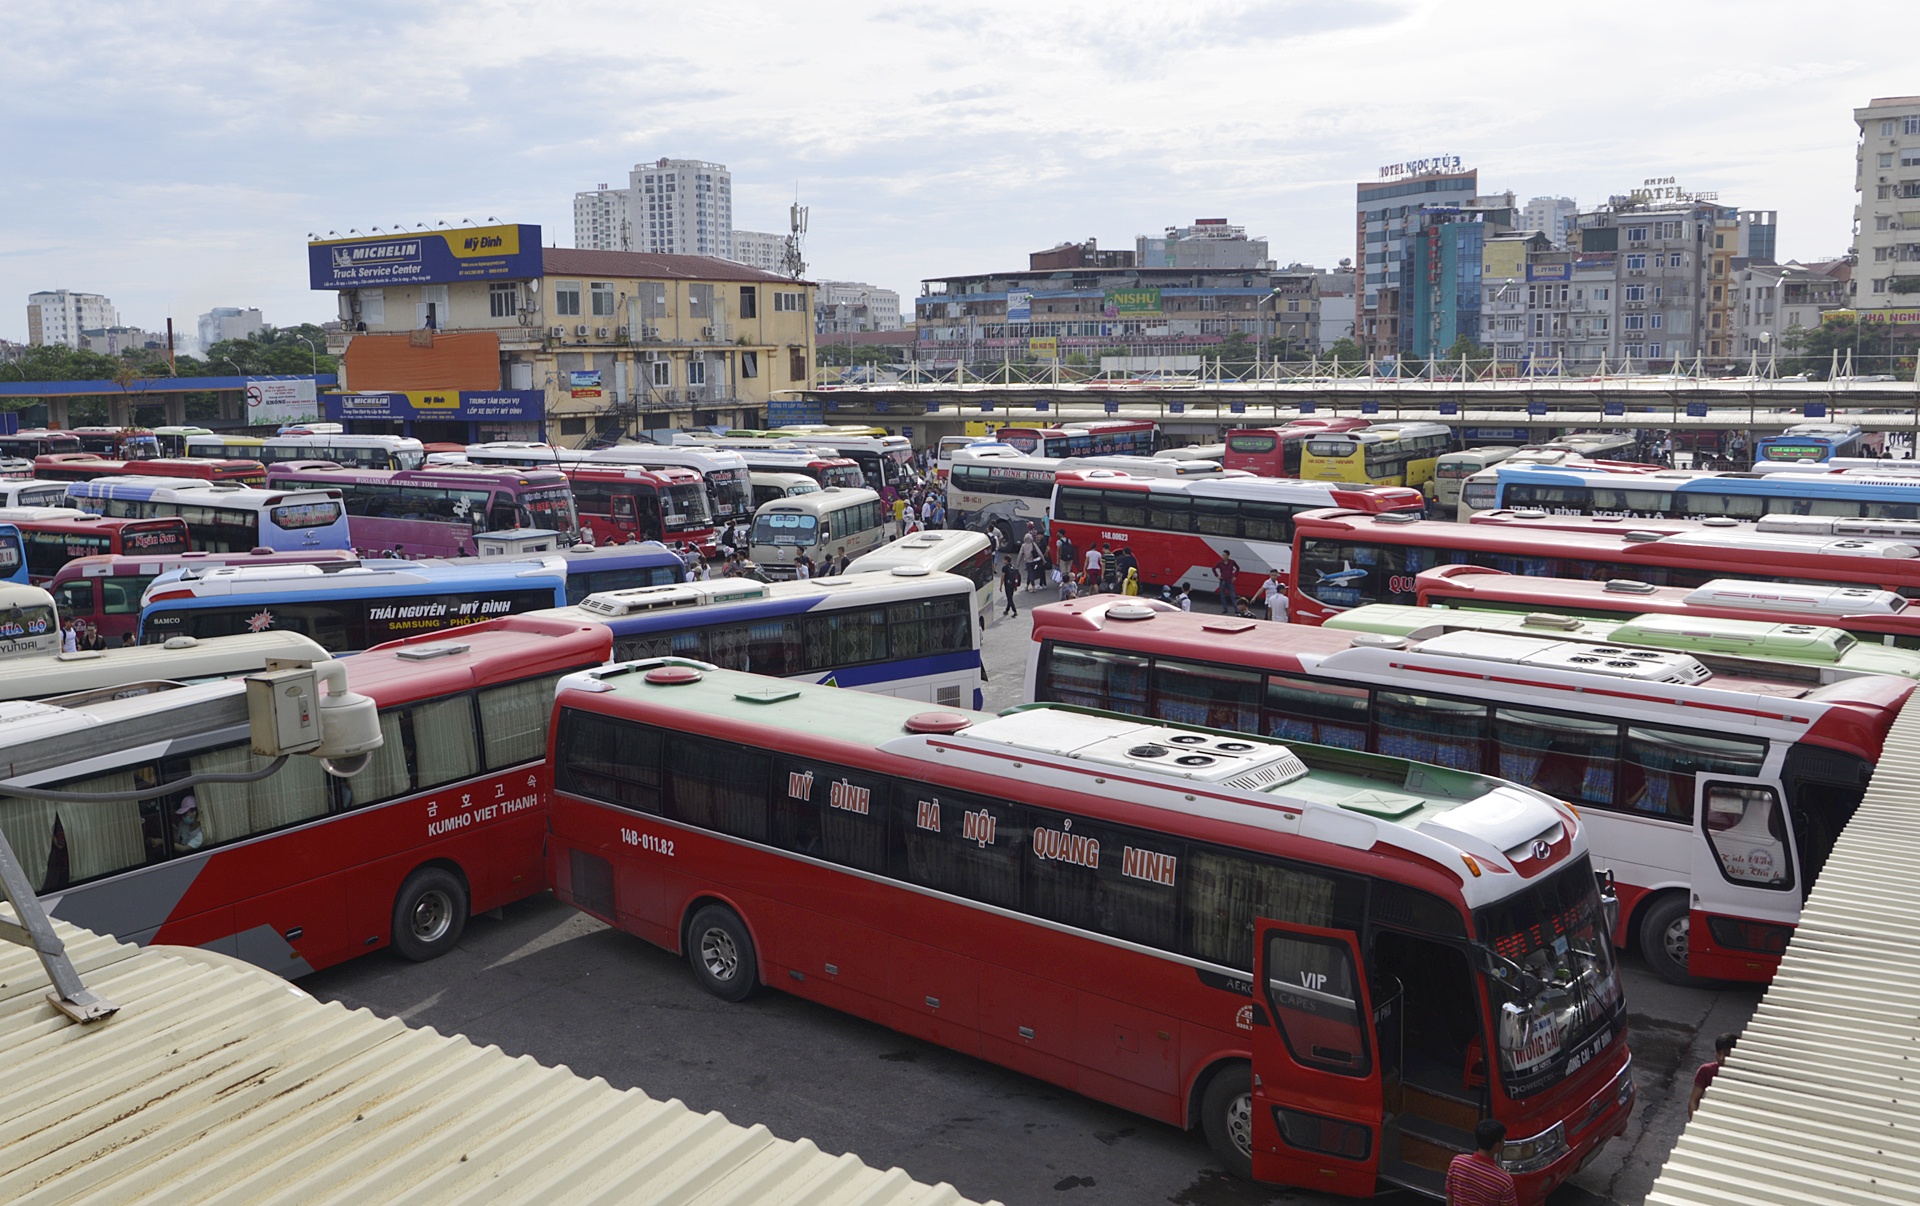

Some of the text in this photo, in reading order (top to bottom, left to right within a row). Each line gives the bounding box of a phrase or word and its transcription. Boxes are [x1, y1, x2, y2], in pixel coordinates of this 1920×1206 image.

[1432, 153, 1451, 169] TÚ
[1452, 156, 1461, 167] 3
[1630, 186, 1683, 202] HOTEL
[1694, 191, 1718, 201] HOTEL
[464, 235, 502, 252] Mỹ Đình
[352, 244, 417, 260] MICHELIN
[333, 264, 422, 279] Truck Service Center
[1114, 293, 1156, 304] NISHU
[469, 397, 486, 405] TRUNG
[487, 396, 498, 405] TÂM
[498, 397, 511, 406] DỊCH
[467, 407, 478, 415] LỐP
[991, 467, 1002, 477] MỸ
[1003, 467, 1021, 478] ĐÌNH
[391, 479, 419, 487] EXPRESS
[21, 495, 44, 504] KUMHO
[135, 533, 176, 549] Ngân Sơn
[847, 536, 862, 547] PTC
[370, 605, 397, 620] THÁI
[398, 601, 447, 619] NGUYÊN
[459, 600, 479, 615] MỸ
[481, 600, 511, 614] ĐÌNH
[28, 616, 47, 633] LỘ
[154, 617, 181, 625] SAMCO
[389, 618, 440, 630] SAMSUNG
[428, 793, 538, 838] KUMHO VIET THANH
[788, 770, 1178, 887] MỸ ĐÌNH HÀ NỘI QUẢNG NINH
[619, 825, 675, 857] 14B-011.82
[1300, 970, 1327, 990] VIP
[1279, 992, 1317, 1012] CAPES
